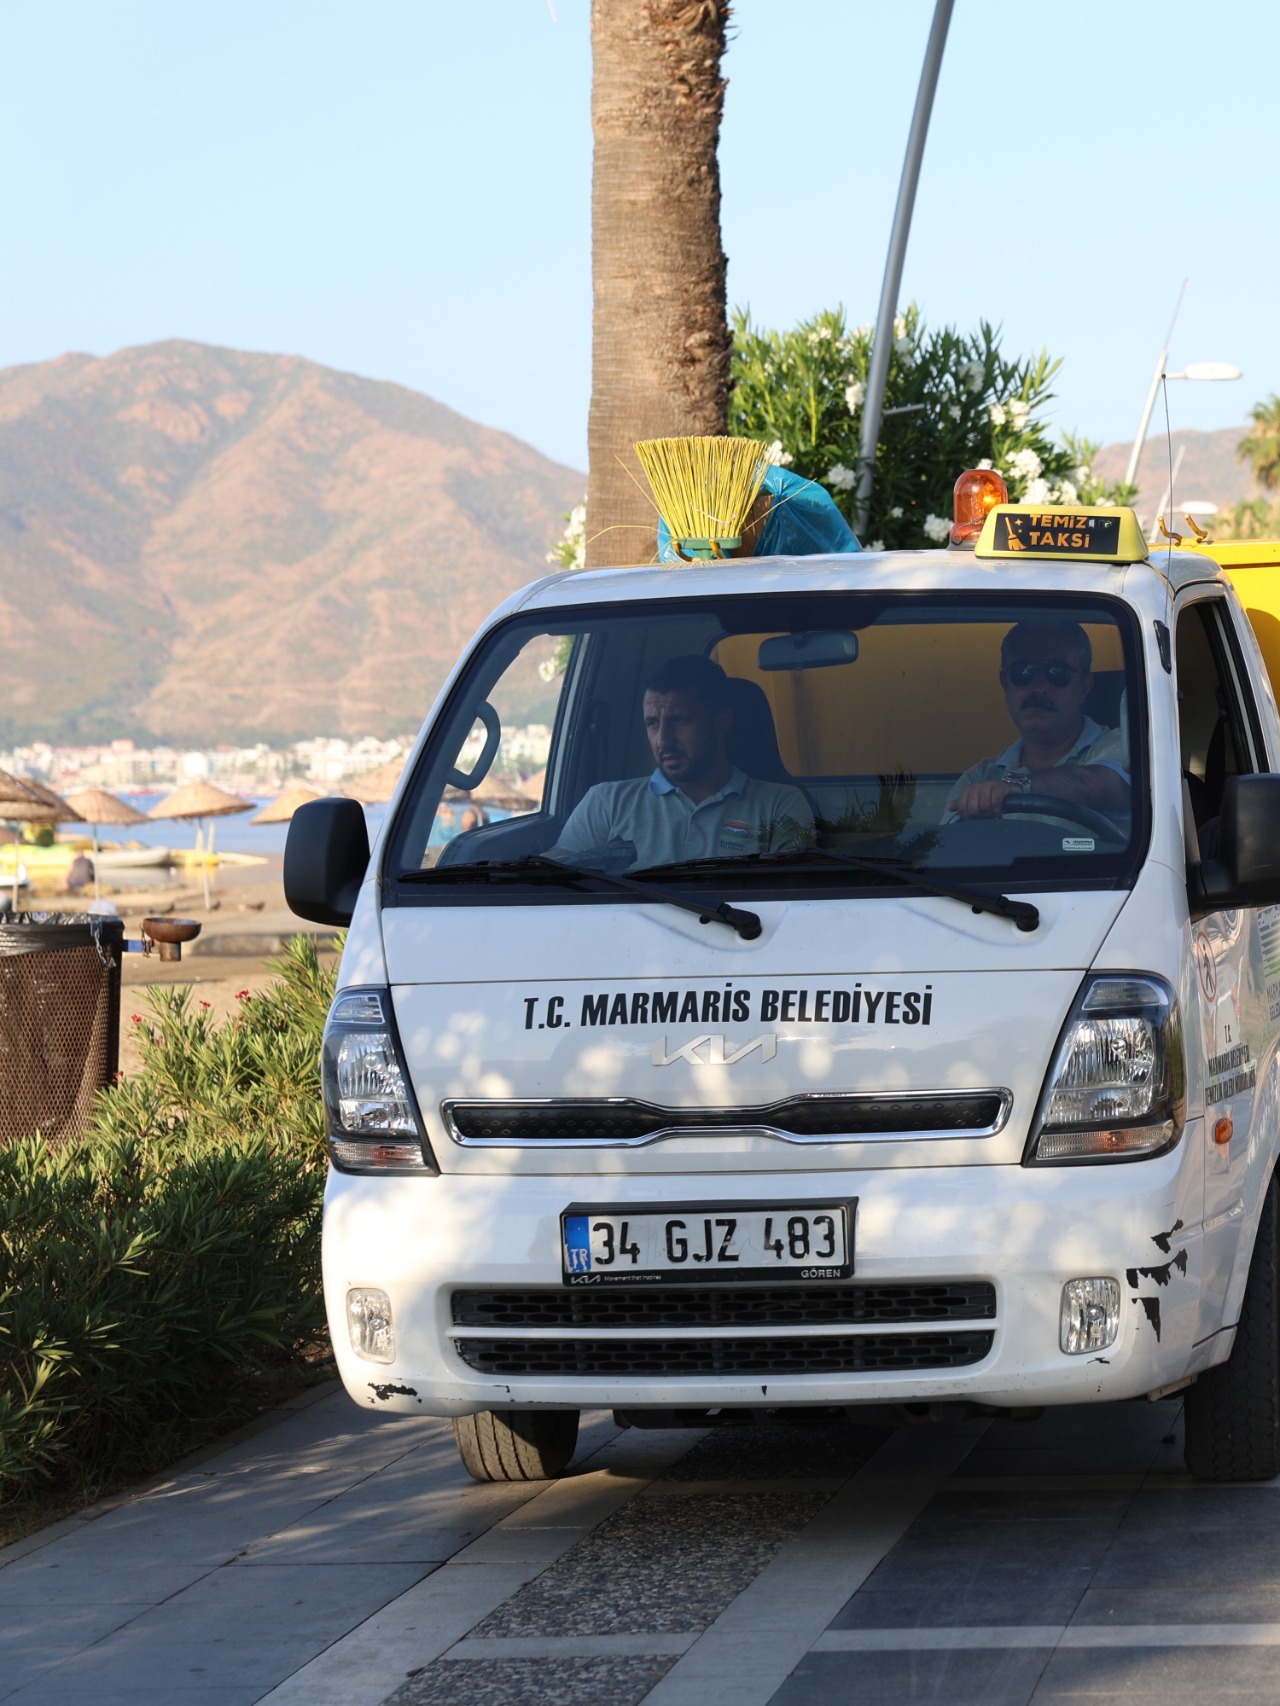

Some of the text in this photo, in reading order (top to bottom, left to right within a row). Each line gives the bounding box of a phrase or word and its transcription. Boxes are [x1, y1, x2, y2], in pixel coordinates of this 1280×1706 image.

[1029, 514, 1088, 529] TEMİZ
[1029, 531, 1091, 548] TAKSİ
[523, 982, 933, 1029] T.C. MARMARİS BELEDİYESİ
[570, 1215, 836, 1270] TR 34 GJZ 483
[801, 1268, 841, 1278] GÖREN
